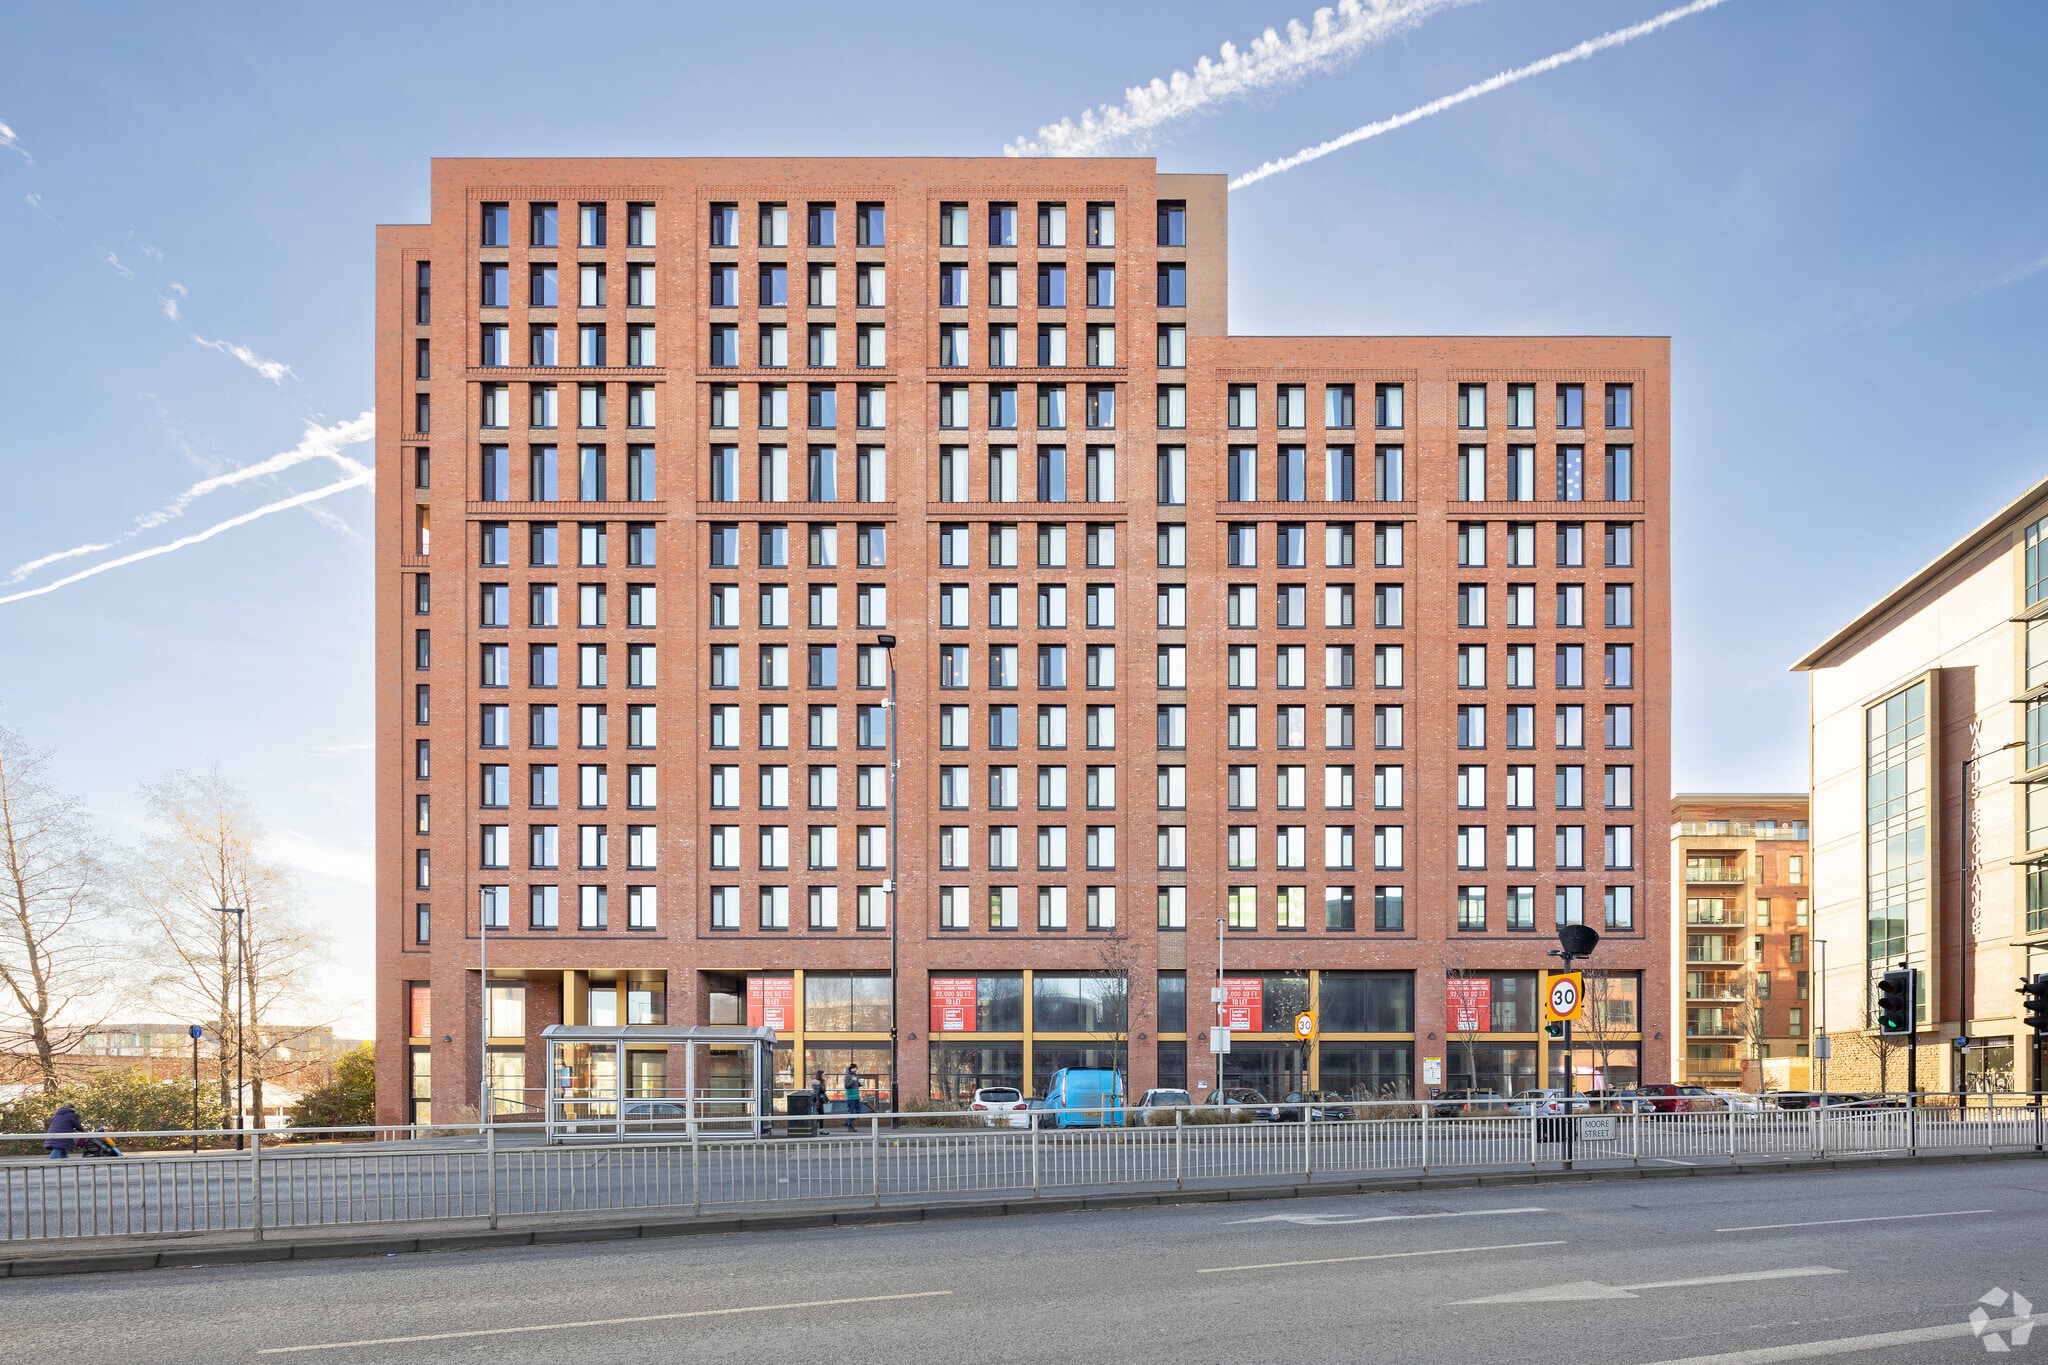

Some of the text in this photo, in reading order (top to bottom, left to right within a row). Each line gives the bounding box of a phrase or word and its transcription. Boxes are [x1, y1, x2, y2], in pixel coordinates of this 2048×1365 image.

[1969, 719, 1983, 937] WARDS EXCHANGE
[1554, 989, 1574, 1006] 30
[1299, 1020, 1310, 1030] 30
[1585, 1120, 1610, 1128] MOORE
[1585, 1129, 1610, 1138] STREET
